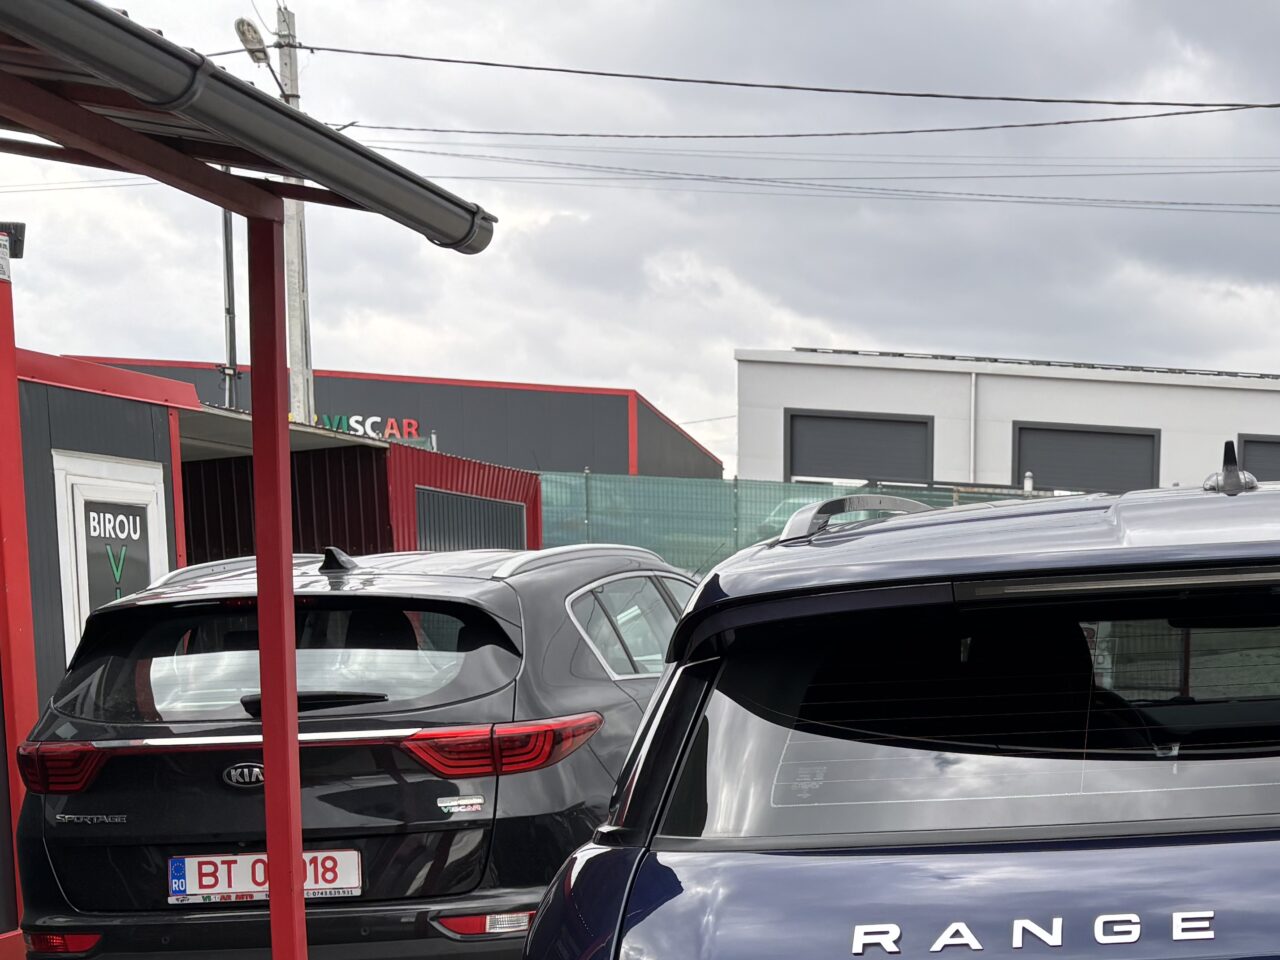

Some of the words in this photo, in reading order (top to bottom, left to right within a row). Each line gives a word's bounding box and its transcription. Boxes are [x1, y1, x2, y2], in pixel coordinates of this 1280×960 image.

[322, 414, 420, 439] VISCAR
[89, 511, 140, 540] BIROU
[55, 814, 127, 824] SPORTAGE
[172, 879, 186, 891] RO
[197, 859, 238, 890] BT
[851, 911, 1215, 955] RANGE
